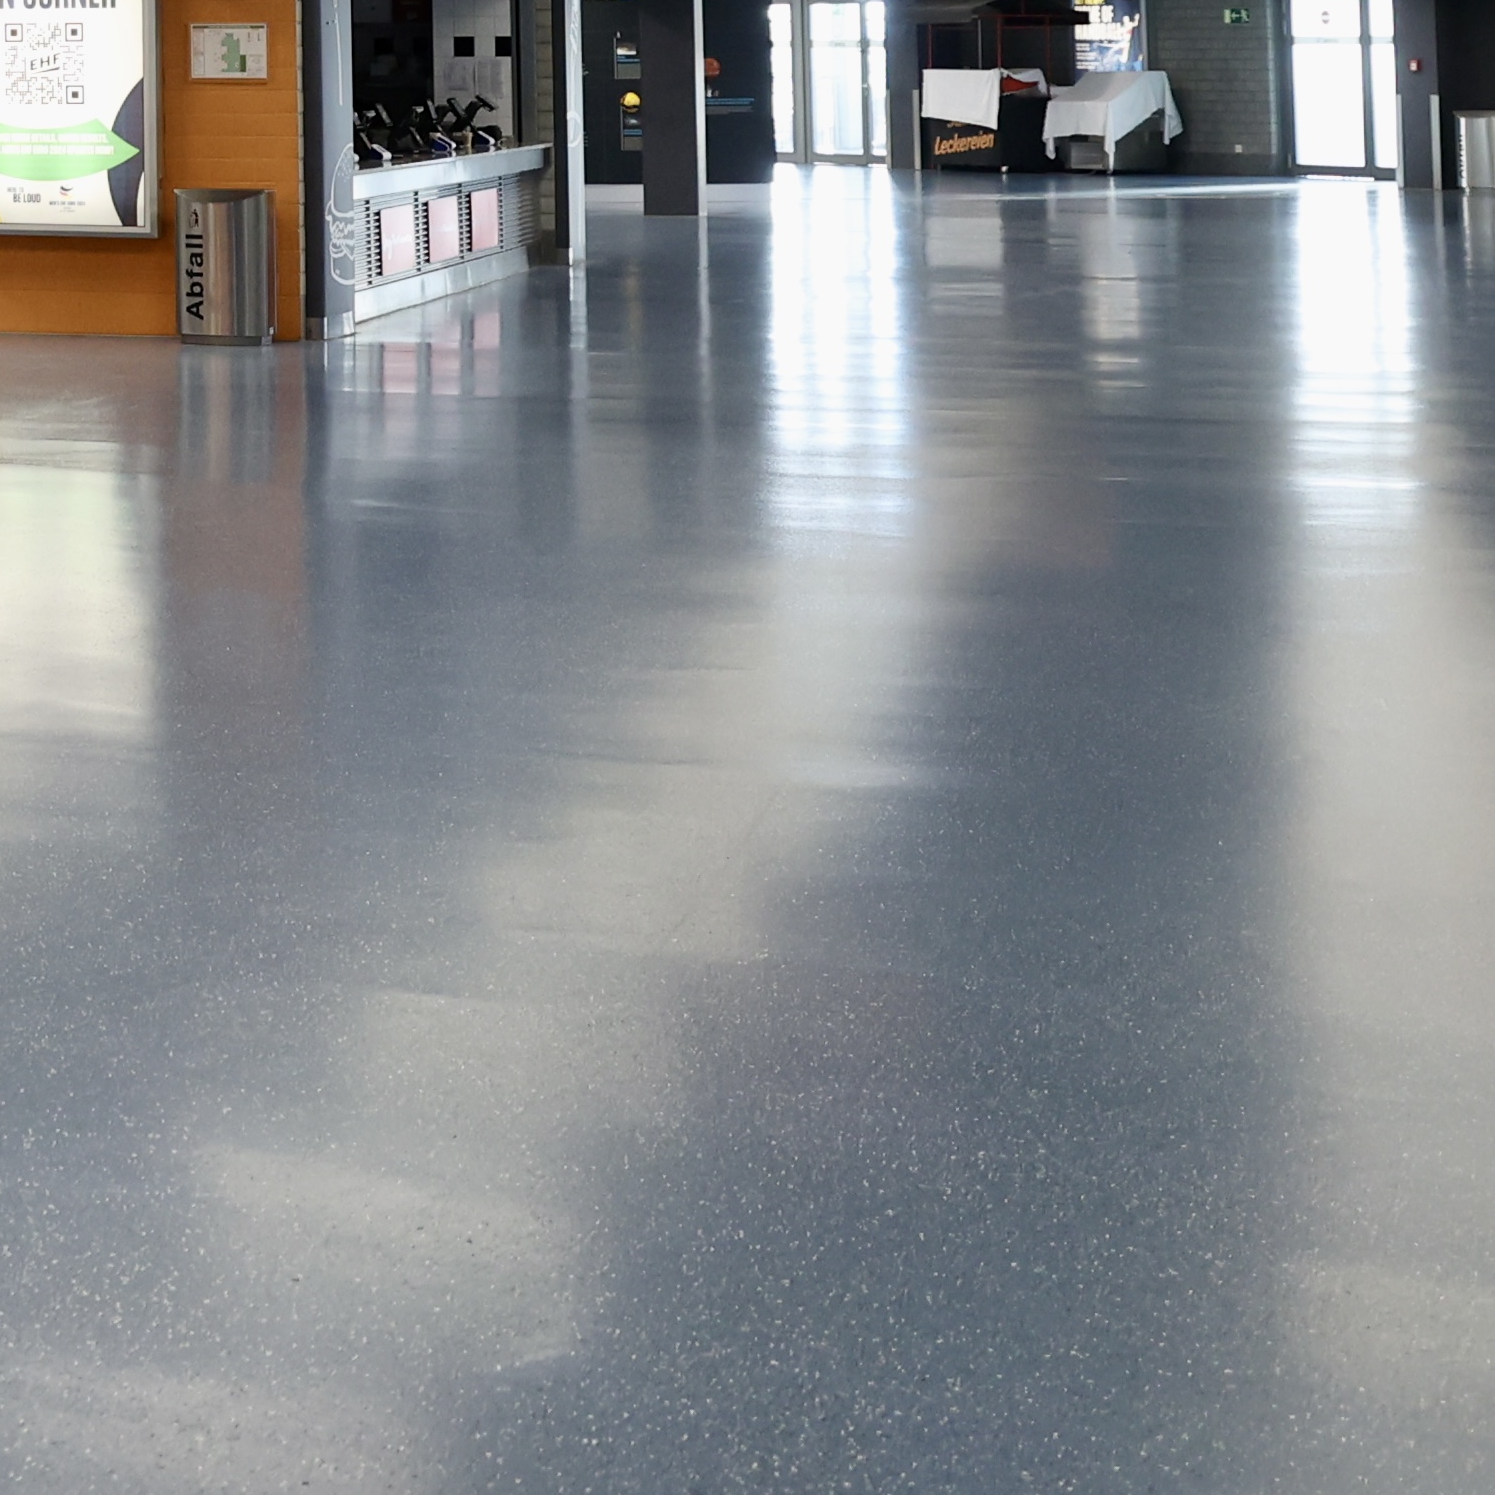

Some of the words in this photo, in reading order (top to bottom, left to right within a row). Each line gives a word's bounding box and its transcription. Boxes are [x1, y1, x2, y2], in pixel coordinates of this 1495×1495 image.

[30, 53, 61, 71] EHF
[934, 130, 995, 155] Leckereien
[13, 193, 21, 203] BE
[23, 193, 41, 203] LOUD
[185, 234, 204, 321] Abfall
